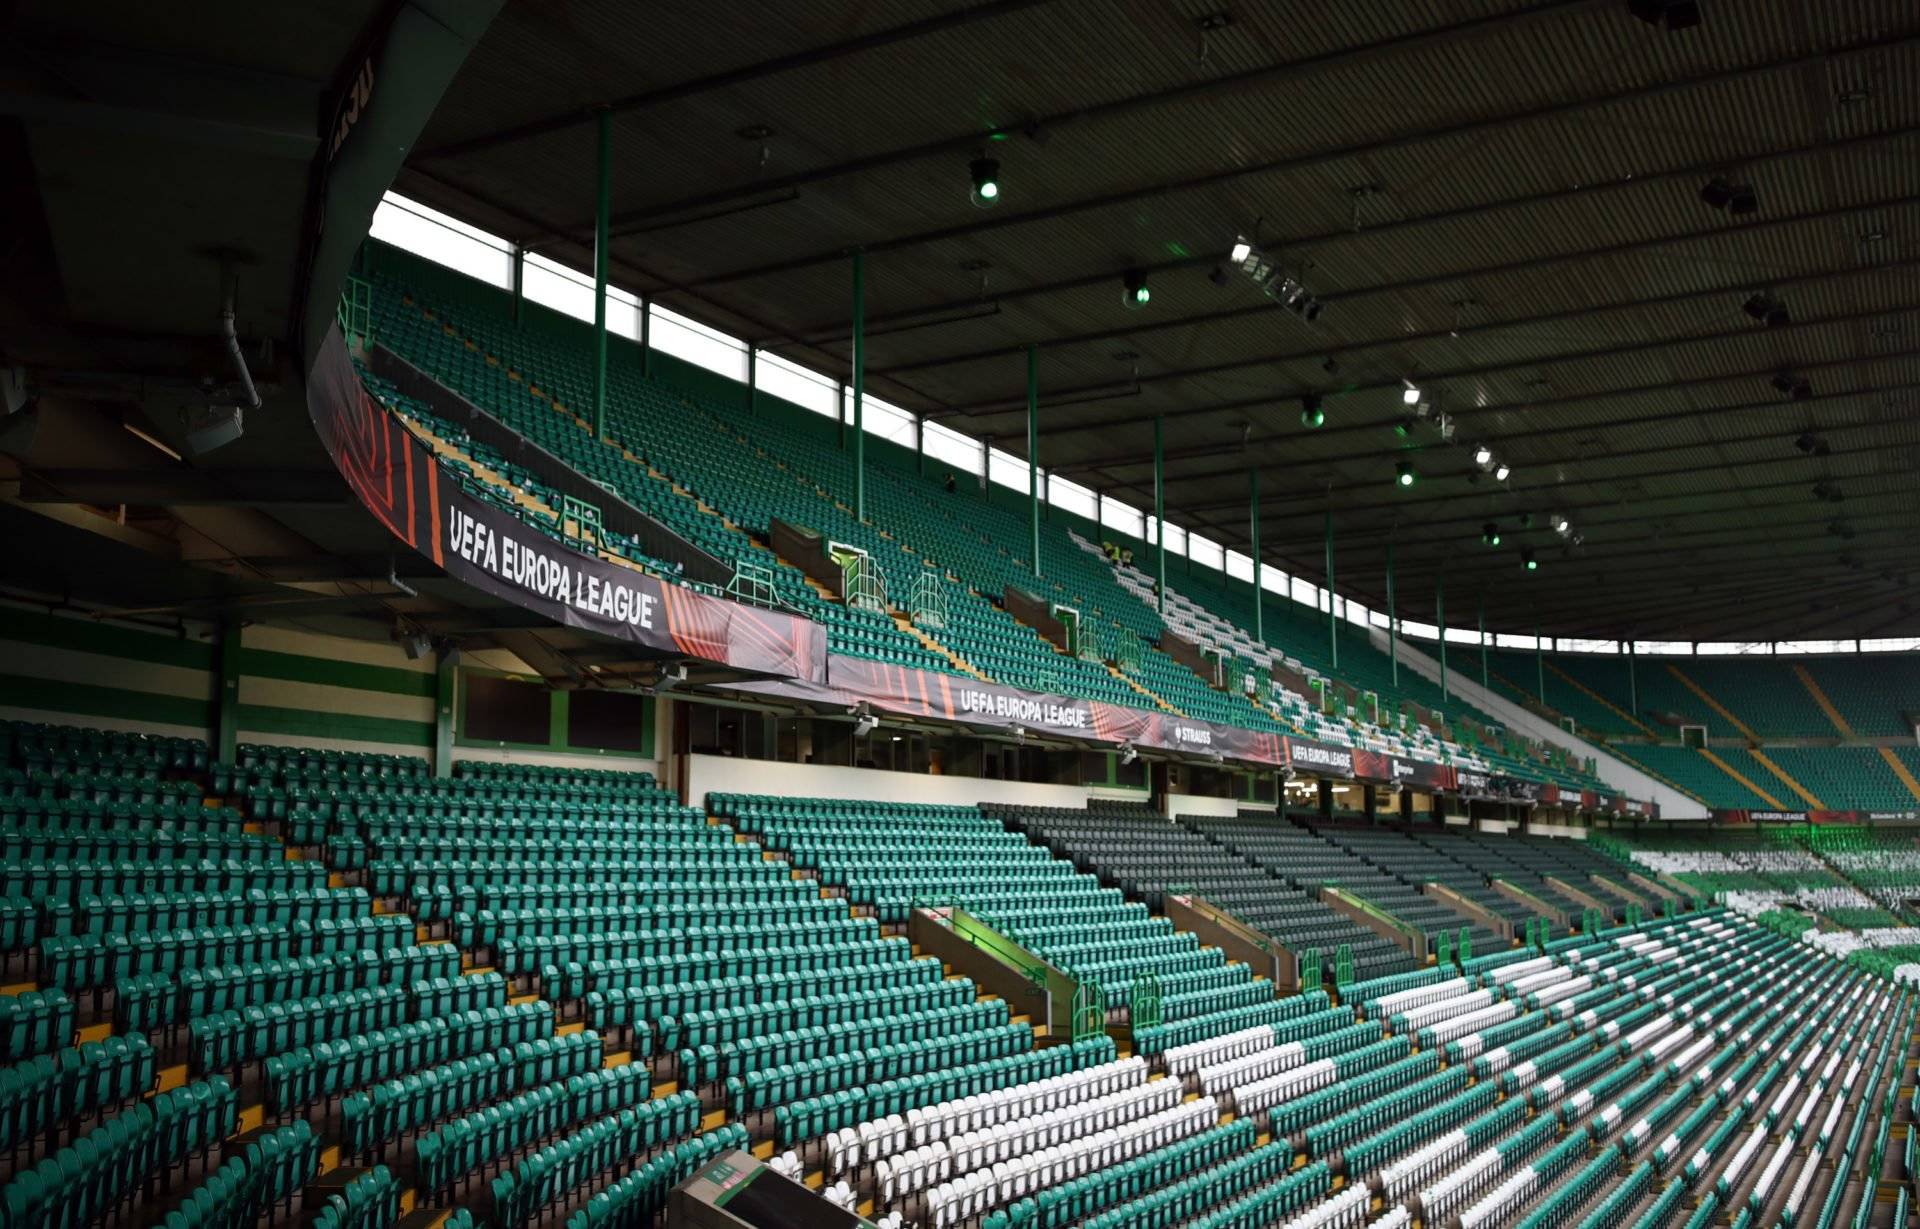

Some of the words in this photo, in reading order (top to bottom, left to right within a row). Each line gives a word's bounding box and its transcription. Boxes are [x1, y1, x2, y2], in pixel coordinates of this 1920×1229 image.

[450, 505, 498, 574] UEFA
[502, 536, 571, 605] EUROPA
[960, 689, 994, 714] UEFA
[996, 696, 1042, 722] EUROPA
[1044, 703, 1086, 728] LEAGUE
[1181, 727, 1212, 745] STRAUSS
[1292, 745, 1308, 761] UEFA
[1308, 748, 1329, 764] EUROPA
[1330, 752, 1351, 768] LEAGUE
